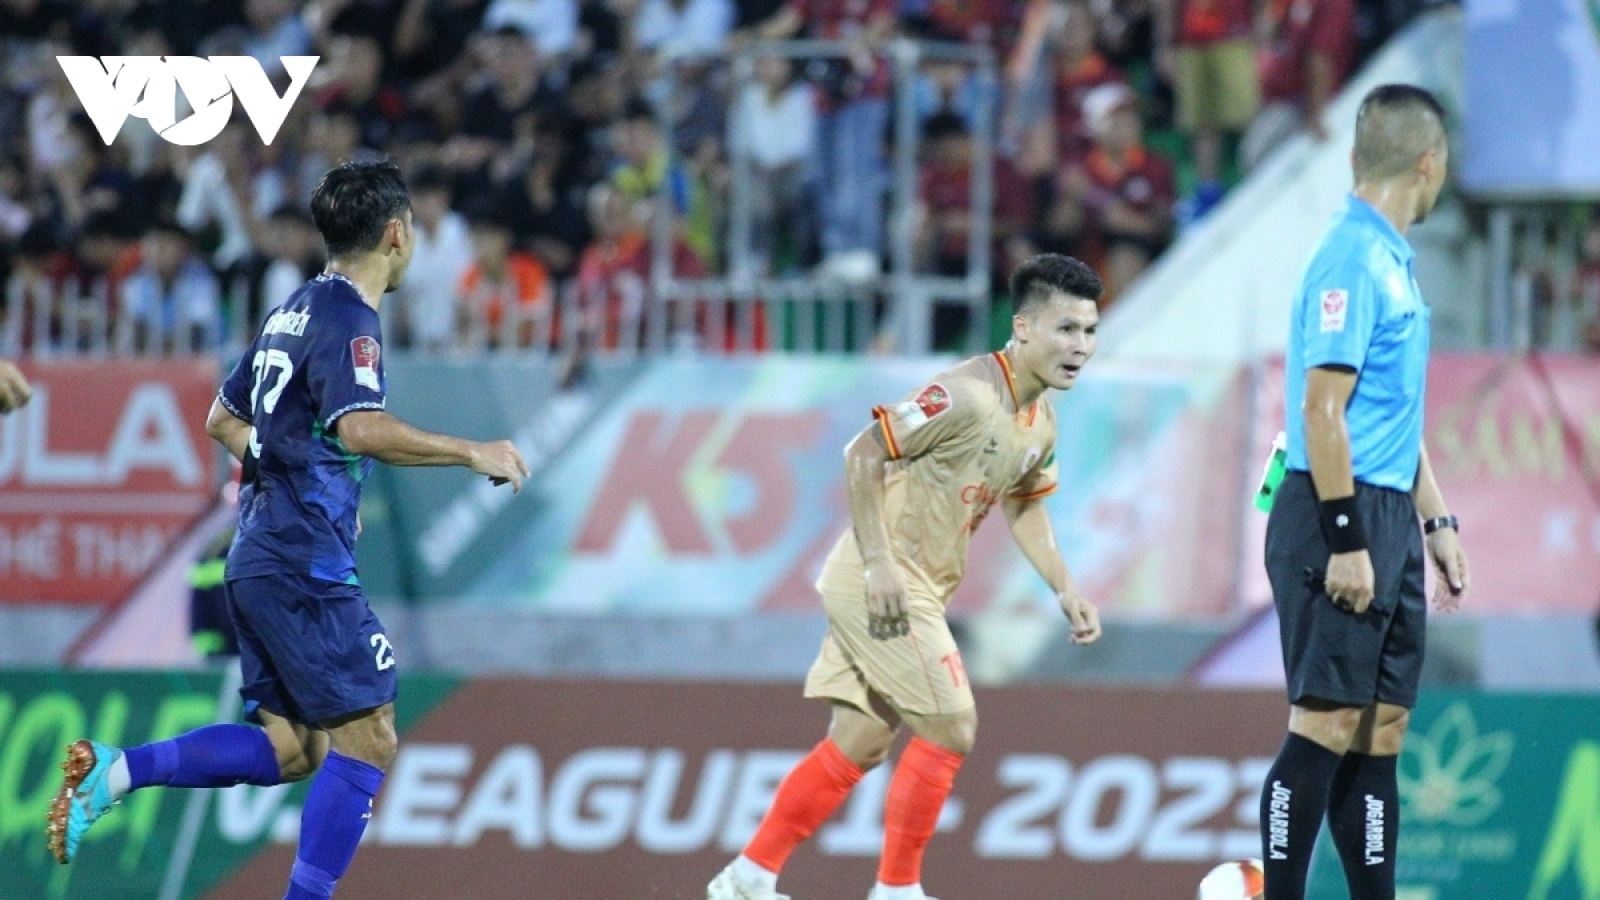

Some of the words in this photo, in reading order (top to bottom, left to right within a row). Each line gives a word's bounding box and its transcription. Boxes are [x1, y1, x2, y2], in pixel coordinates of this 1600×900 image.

[573, 406, 830, 558] K5
[0, 690, 217, 862] OLF
[1269, 779, 1292, 861] JOGARBOLA
[1364, 794, 1385, 866] JOGARBOLA
